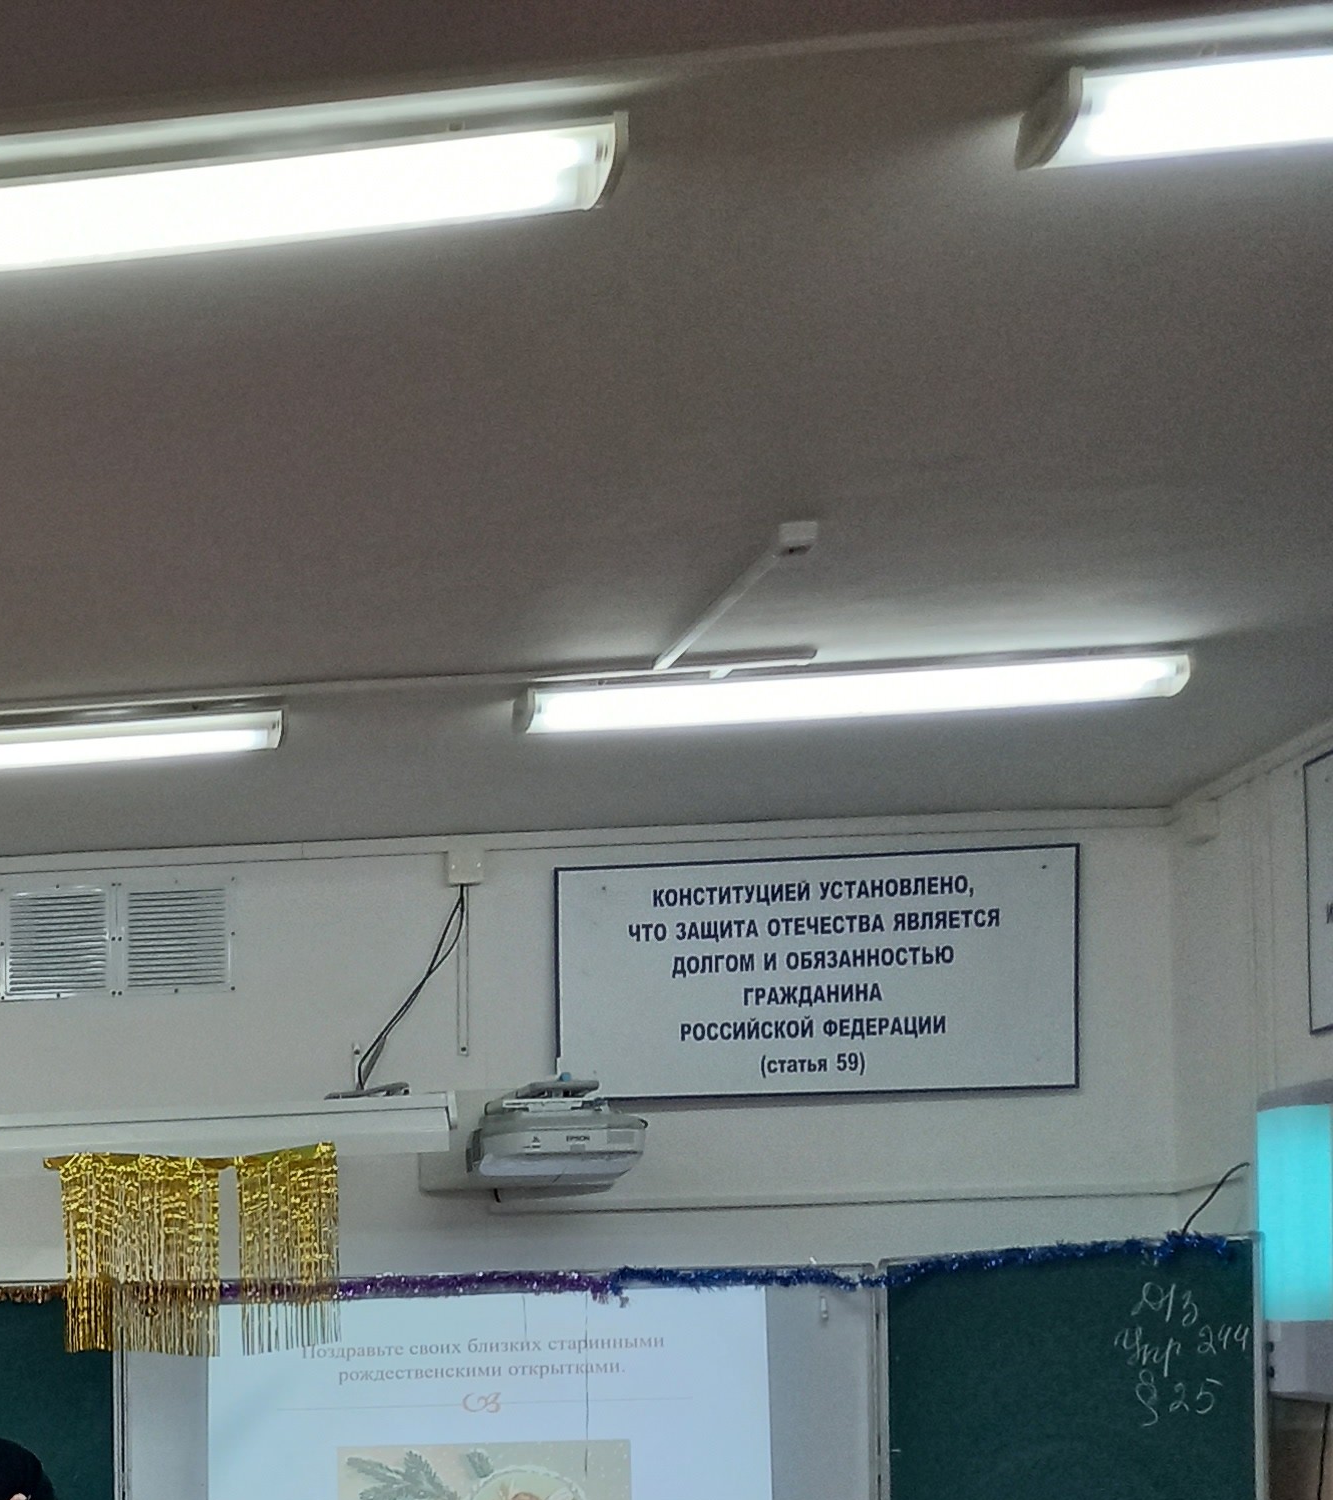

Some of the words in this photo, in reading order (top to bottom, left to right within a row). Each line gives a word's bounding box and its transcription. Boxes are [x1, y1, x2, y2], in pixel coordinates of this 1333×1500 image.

[652, 880, 810, 907] КОНСТИТУЦИЕЙ
[819, 875, 974, 900] УСТАНОВЛЕНО,
[628, 923, 667, 942] ЧТО
[675, 919, 759, 943] ЗАЩИТА
[767, 914, 885, 937] ОТЕЧЕСТВА
[893, 908, 1000, 931] ЯВЛЯЕТСЯ
[672, 952, 755, 978] ДОЛГОМ
[763, 952, 777, 971] И
[786, 945, 954, 970] ОБЯЗАННОСТЬЮ
[743, 983, 882, 1007] ГРАЖДАНИНА
[680, 1016, 814, 1041] РОССИЙСКОЙ
[823, 1015, 946, 1039] ФЕДЕРАЦИИ
[760, 1054, 827, 1078] (статья
[837, 1051, 866, 1075] 59)
[409, 1342, 462, 1356] своих
[467, 1338, 542, 1354] близких
[548, 1334, 665, 1353] старинными
[1198, 1324, 1250, 1354] 244
[338, 1363, 502, 1385] рождественскими
[508, 1361, 625, 1379] открытками.
[1169, 1378, 1223, 1414] 25
